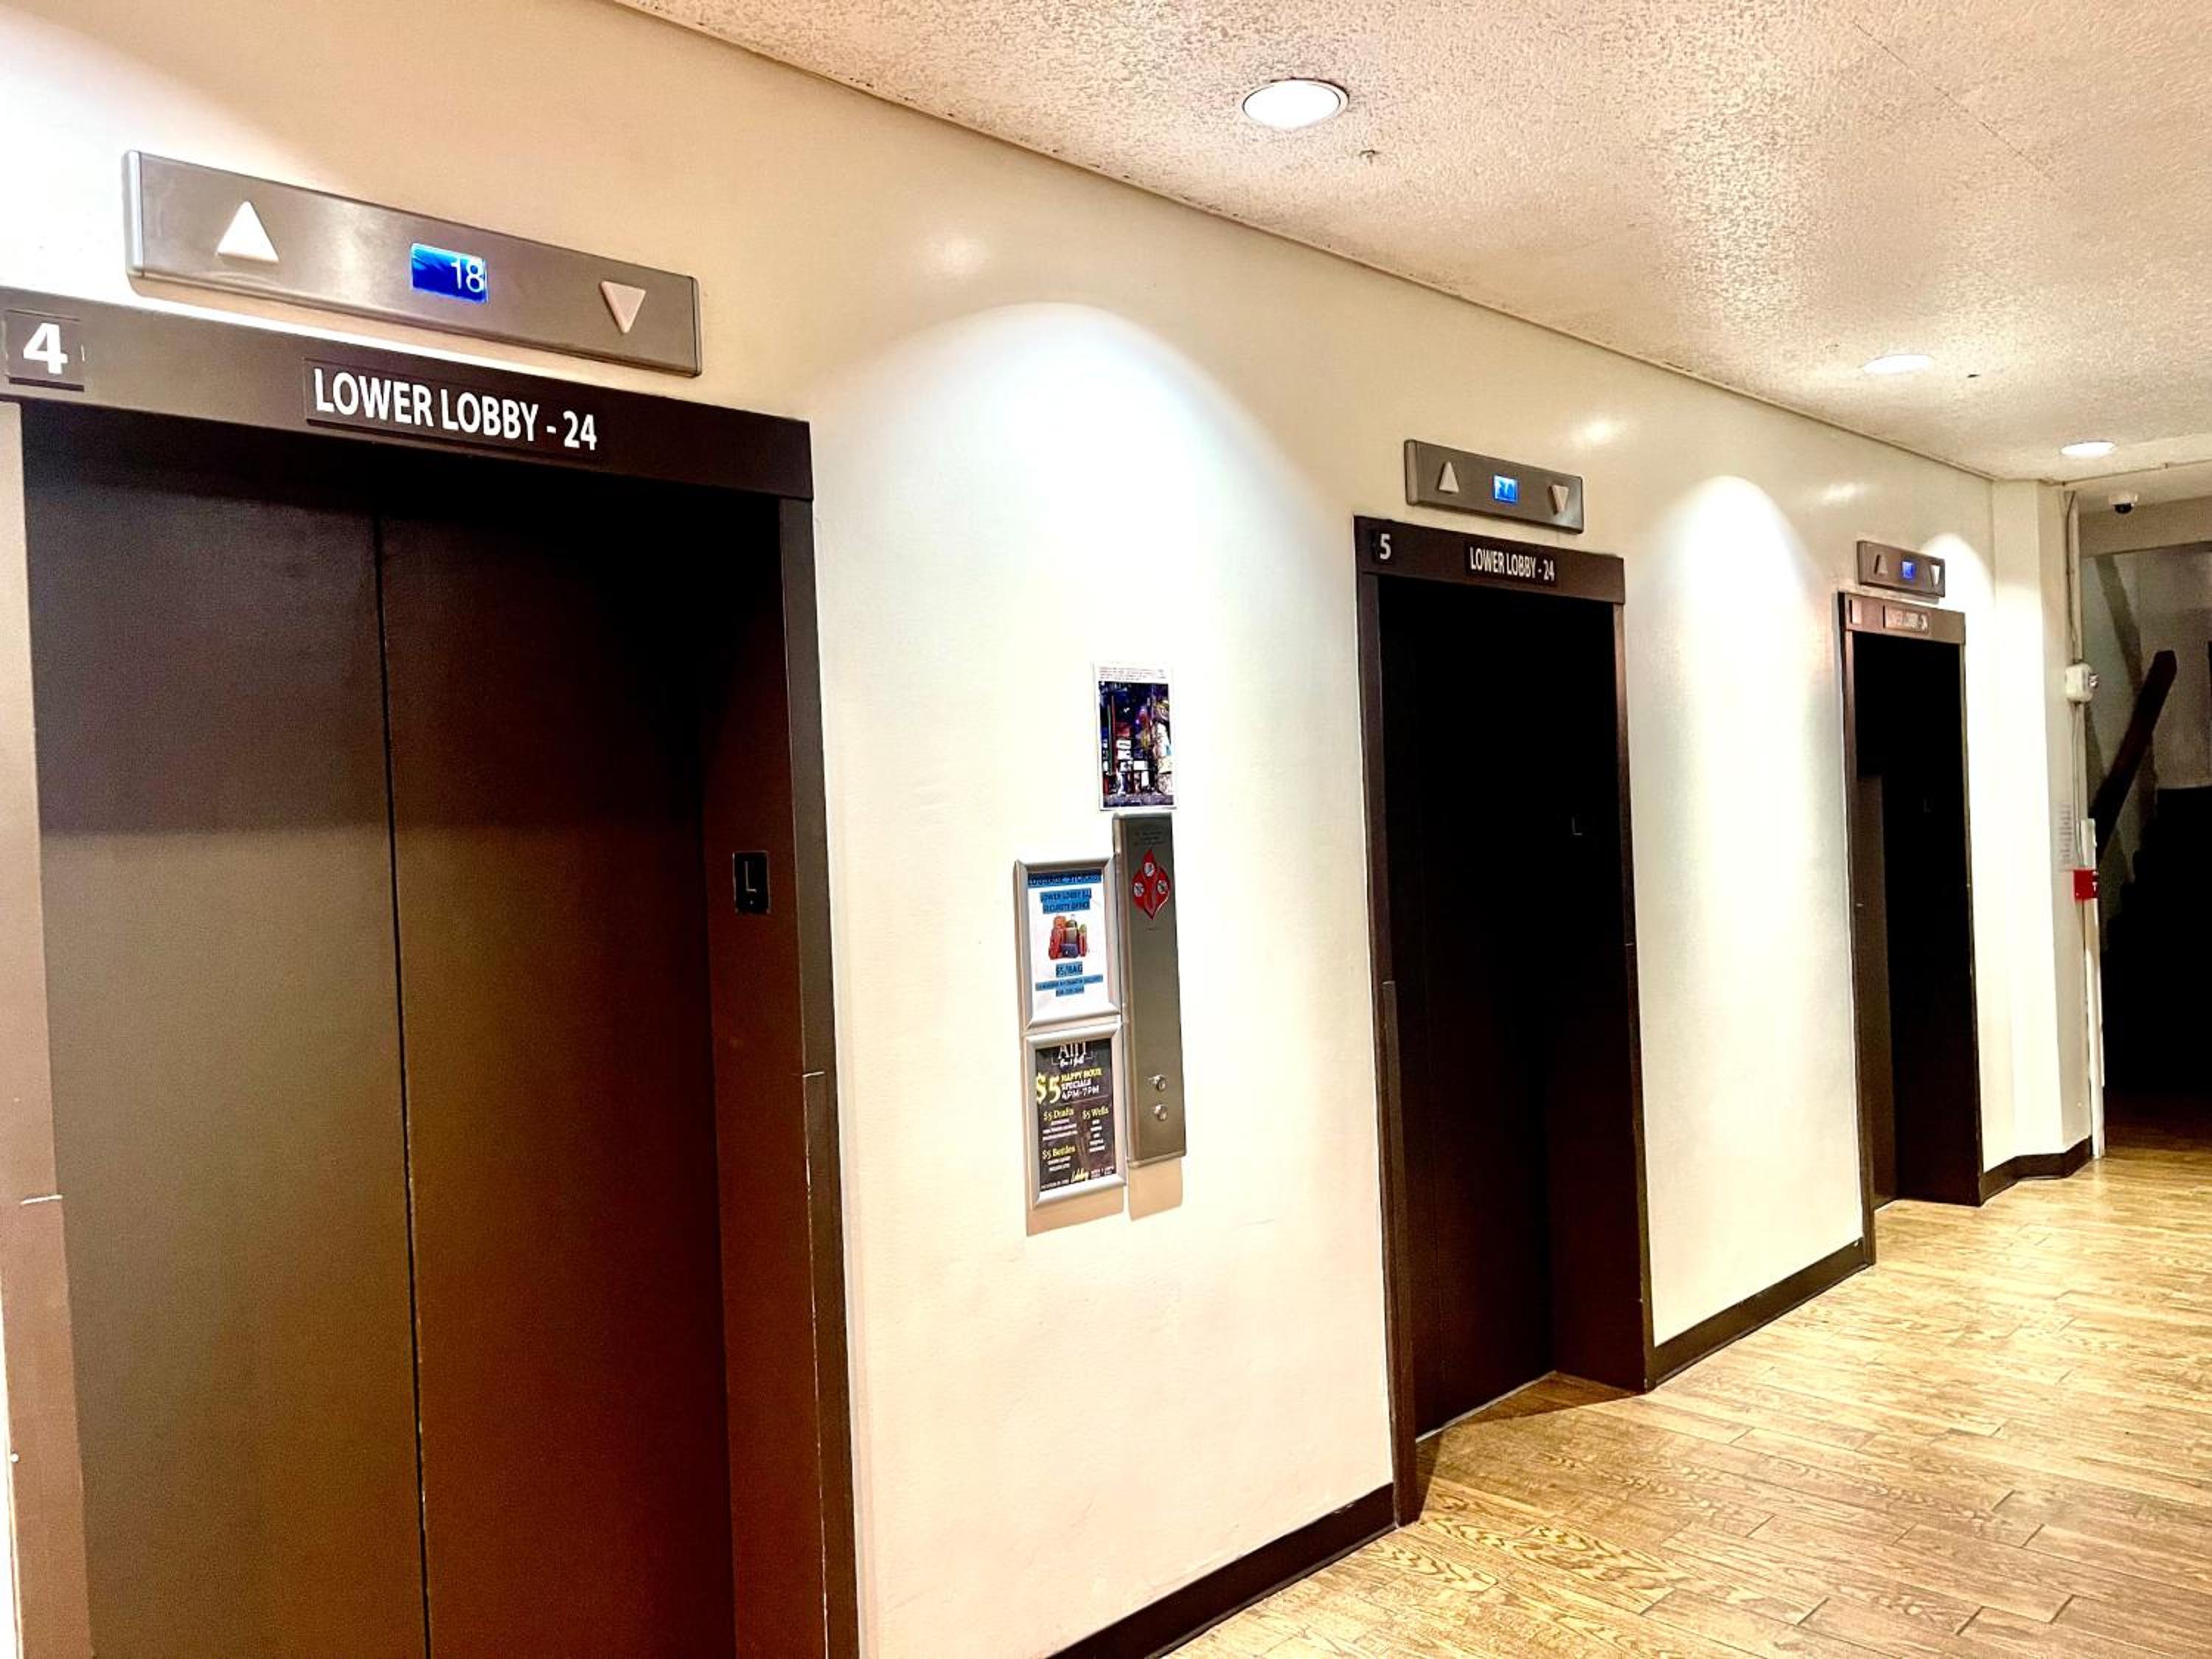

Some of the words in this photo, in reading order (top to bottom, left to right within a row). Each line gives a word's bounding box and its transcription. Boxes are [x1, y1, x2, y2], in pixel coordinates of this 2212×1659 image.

[451, 257, 485, 293] 18
[23, 322, 69, 375] 4
[314, 368, 434, 427] LOWER
[440, 389, 538, 442] LOBBY
[546, 425, 557, 434] -
[563, 410, 597, 451] 24
[1380, 533, 1392, 560] 5
[1470, 546, 1505, 574] LOWER
[1506, 553, 1537, 578] LOBBY
[1543, 560, 1555, 581] 24
[1036, 1071, 1062, 1105] $5
[1062, 1071, 1082, 1082] HAPPY
[1083, 1068, 1102, 1078] HOUR
[1062, 1078, 1091, 1091] SPECIALS
